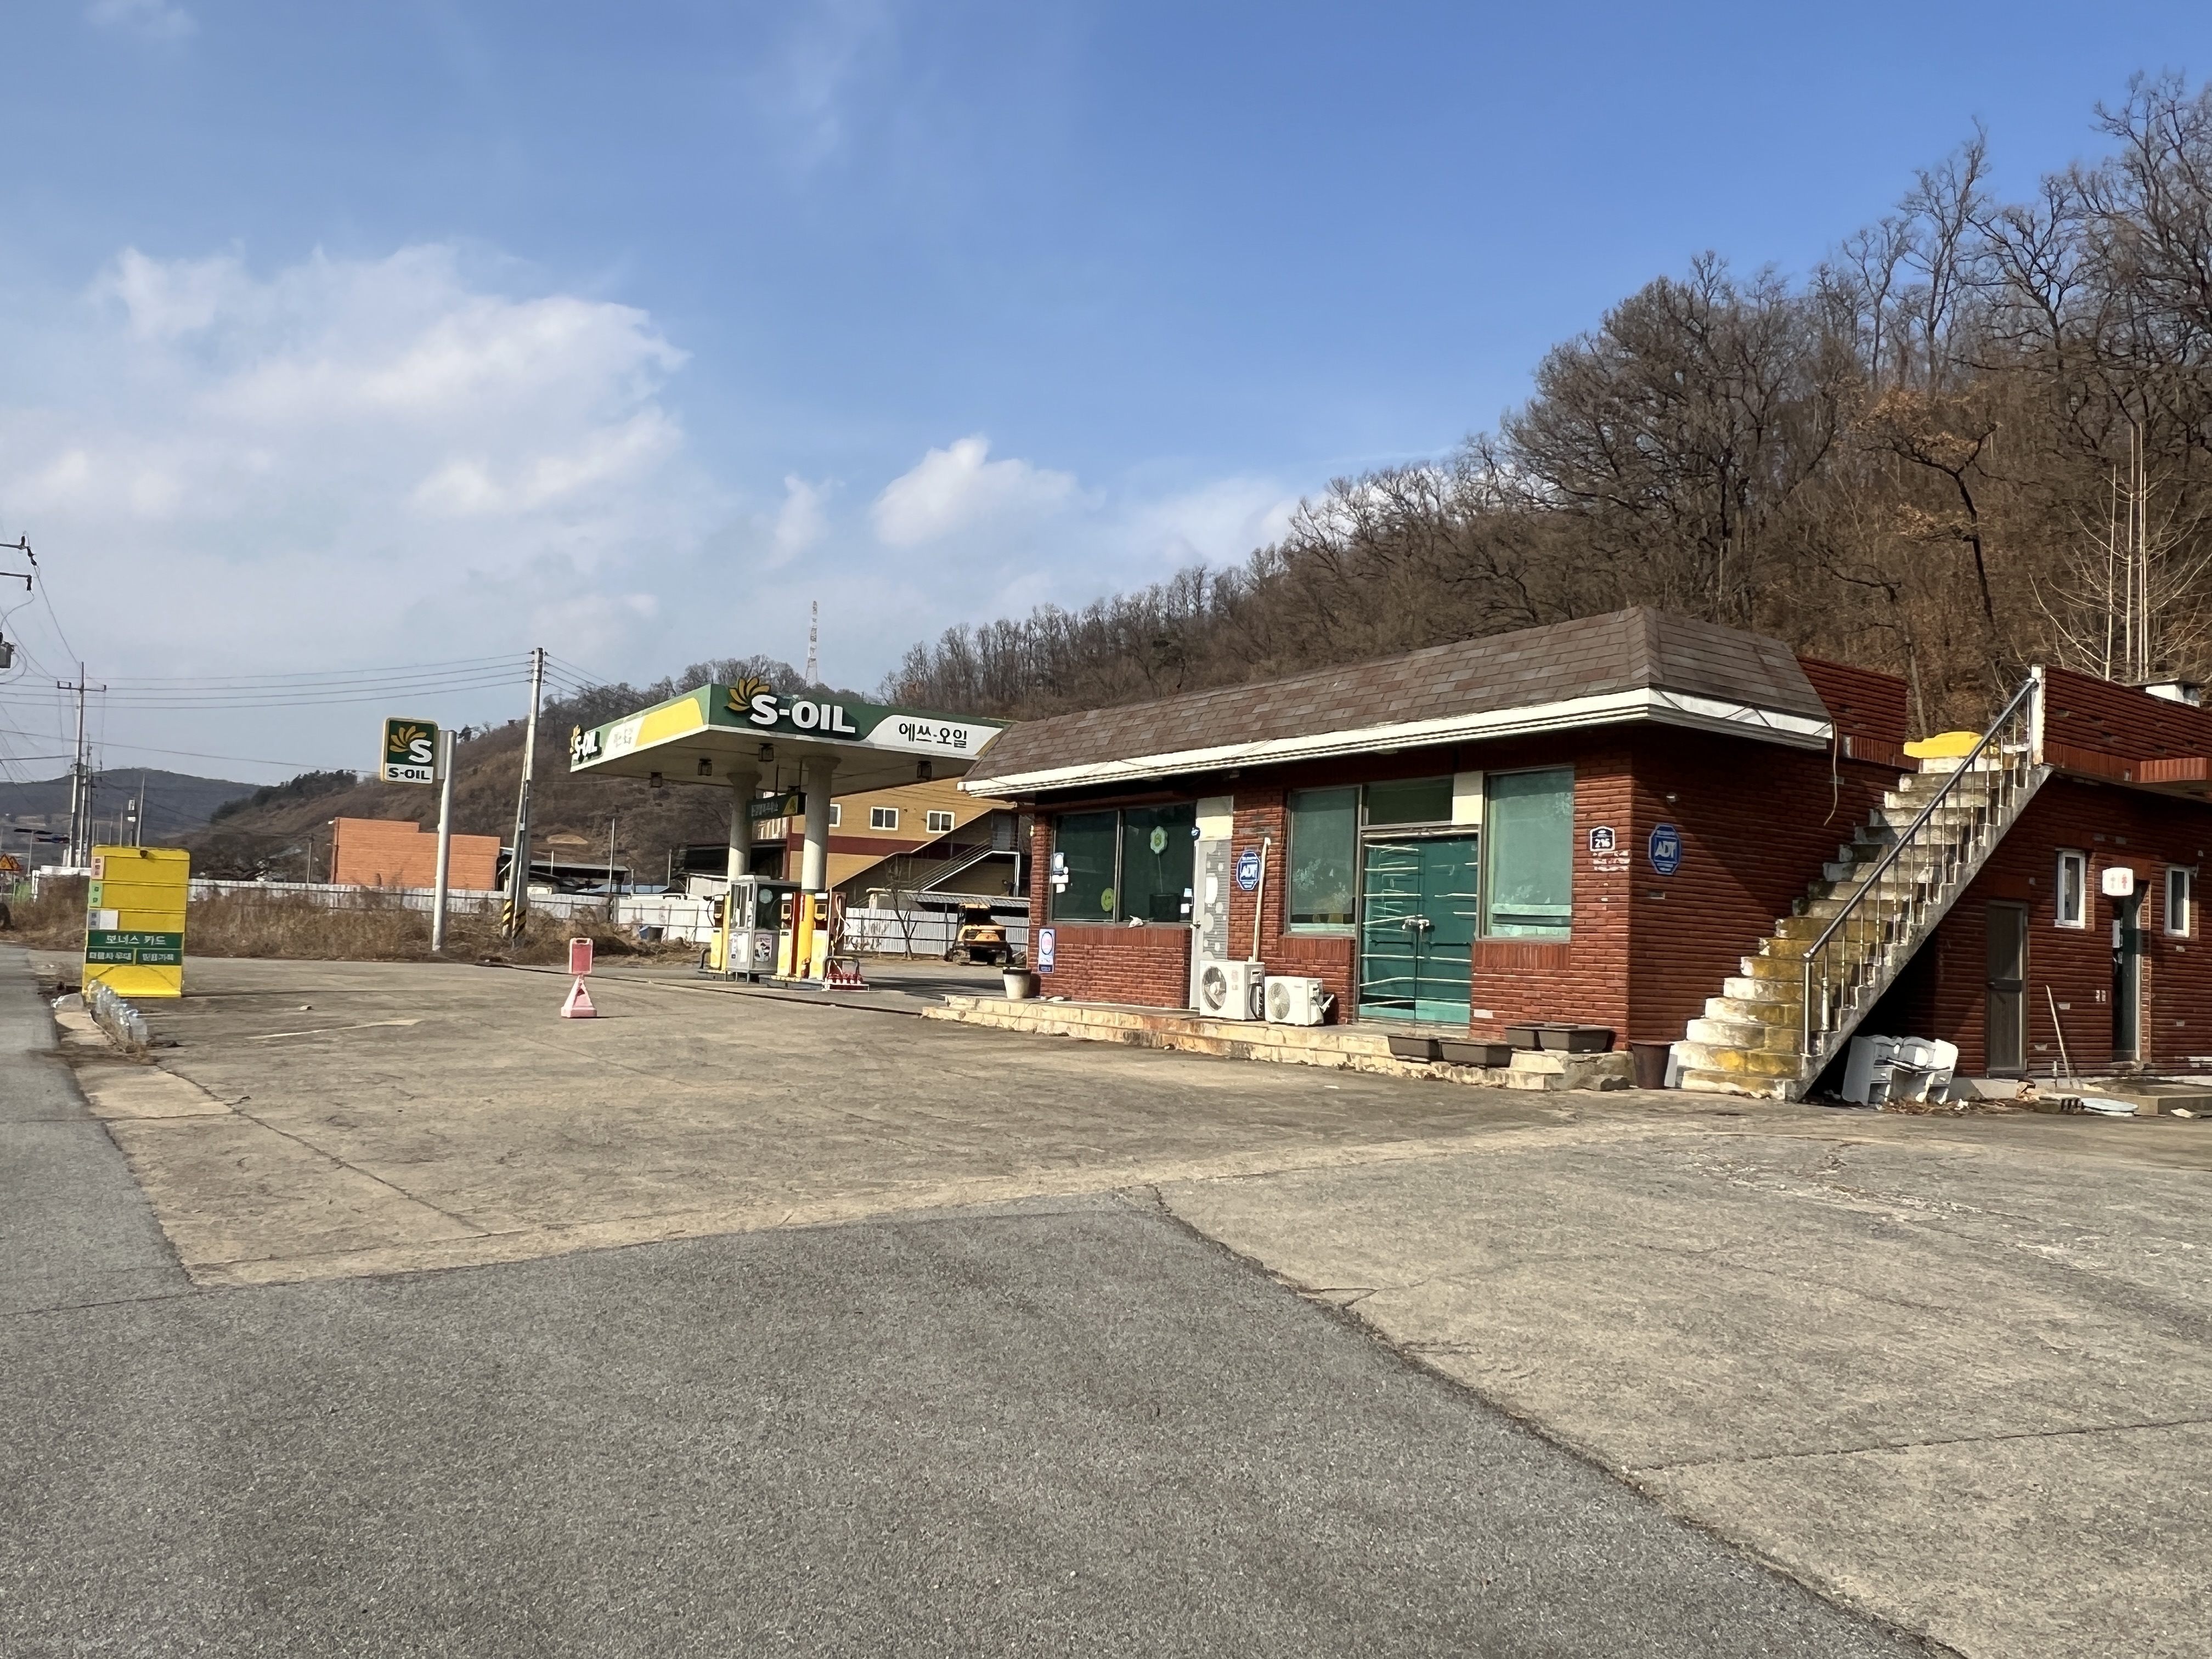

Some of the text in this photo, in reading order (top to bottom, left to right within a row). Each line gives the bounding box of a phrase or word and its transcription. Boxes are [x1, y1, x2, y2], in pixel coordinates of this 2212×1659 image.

[749, 694, 856, 733] S-OIL
[388, 767, 431, 780] S-OIL
[1655, 840, 1678, 859] ADT
[1240, 864, 1258, 878] ADT
